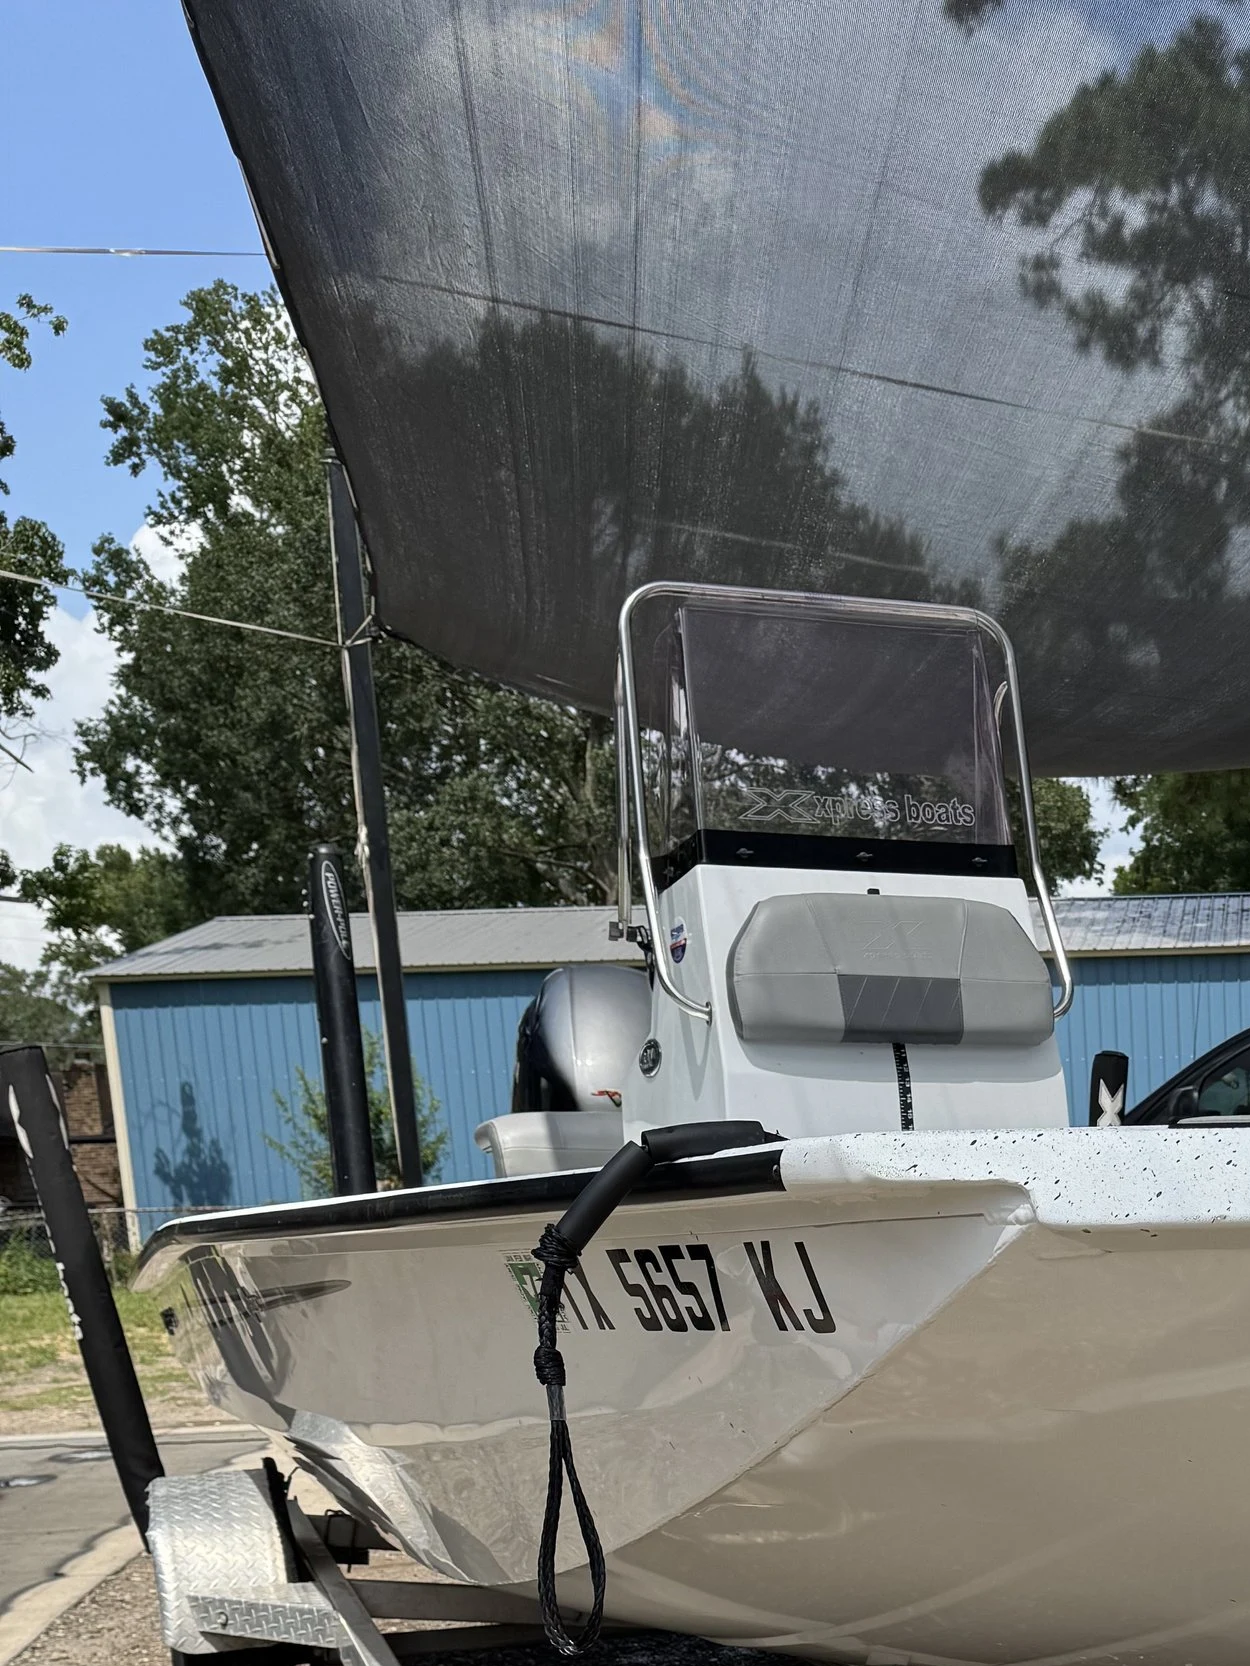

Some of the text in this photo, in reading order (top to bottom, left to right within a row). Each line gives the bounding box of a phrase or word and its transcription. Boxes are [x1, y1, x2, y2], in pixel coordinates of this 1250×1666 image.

[813, 795, 900, 825] xpress
[904, 795, 976, 827] boats
[604, 1243, 732, 1333] 5657
[742, 1240, 837, 1334] KJ
